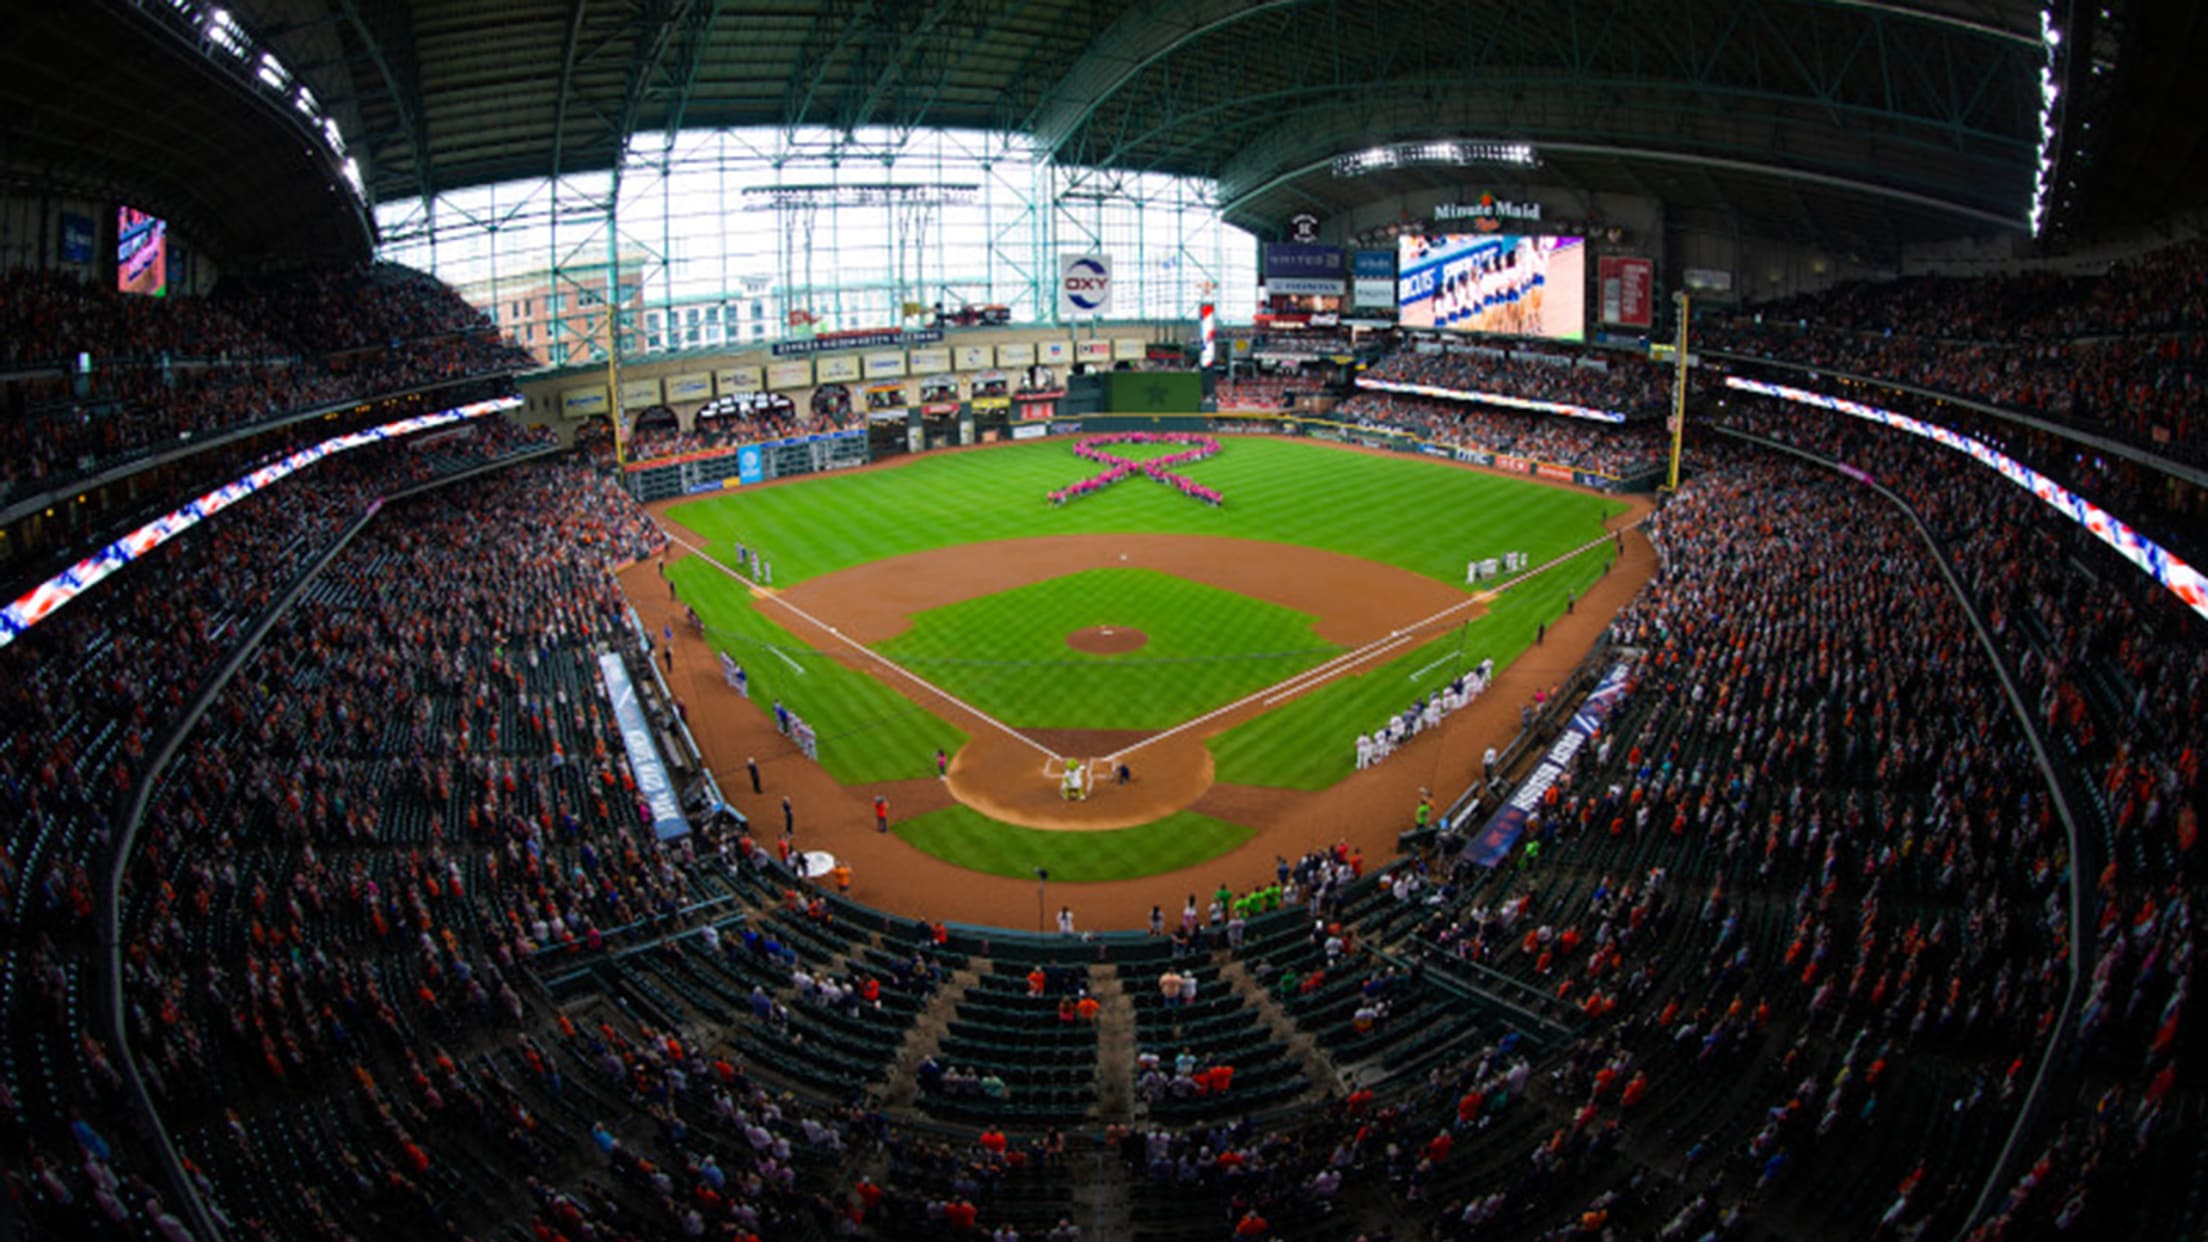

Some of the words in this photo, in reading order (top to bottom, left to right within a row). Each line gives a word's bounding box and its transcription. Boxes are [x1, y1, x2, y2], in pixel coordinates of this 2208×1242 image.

[1434, 203, 1493, 221] Minute
[1496, 200, 1540, 220] Maid
[1064, 277, 1109, 291] OXY
